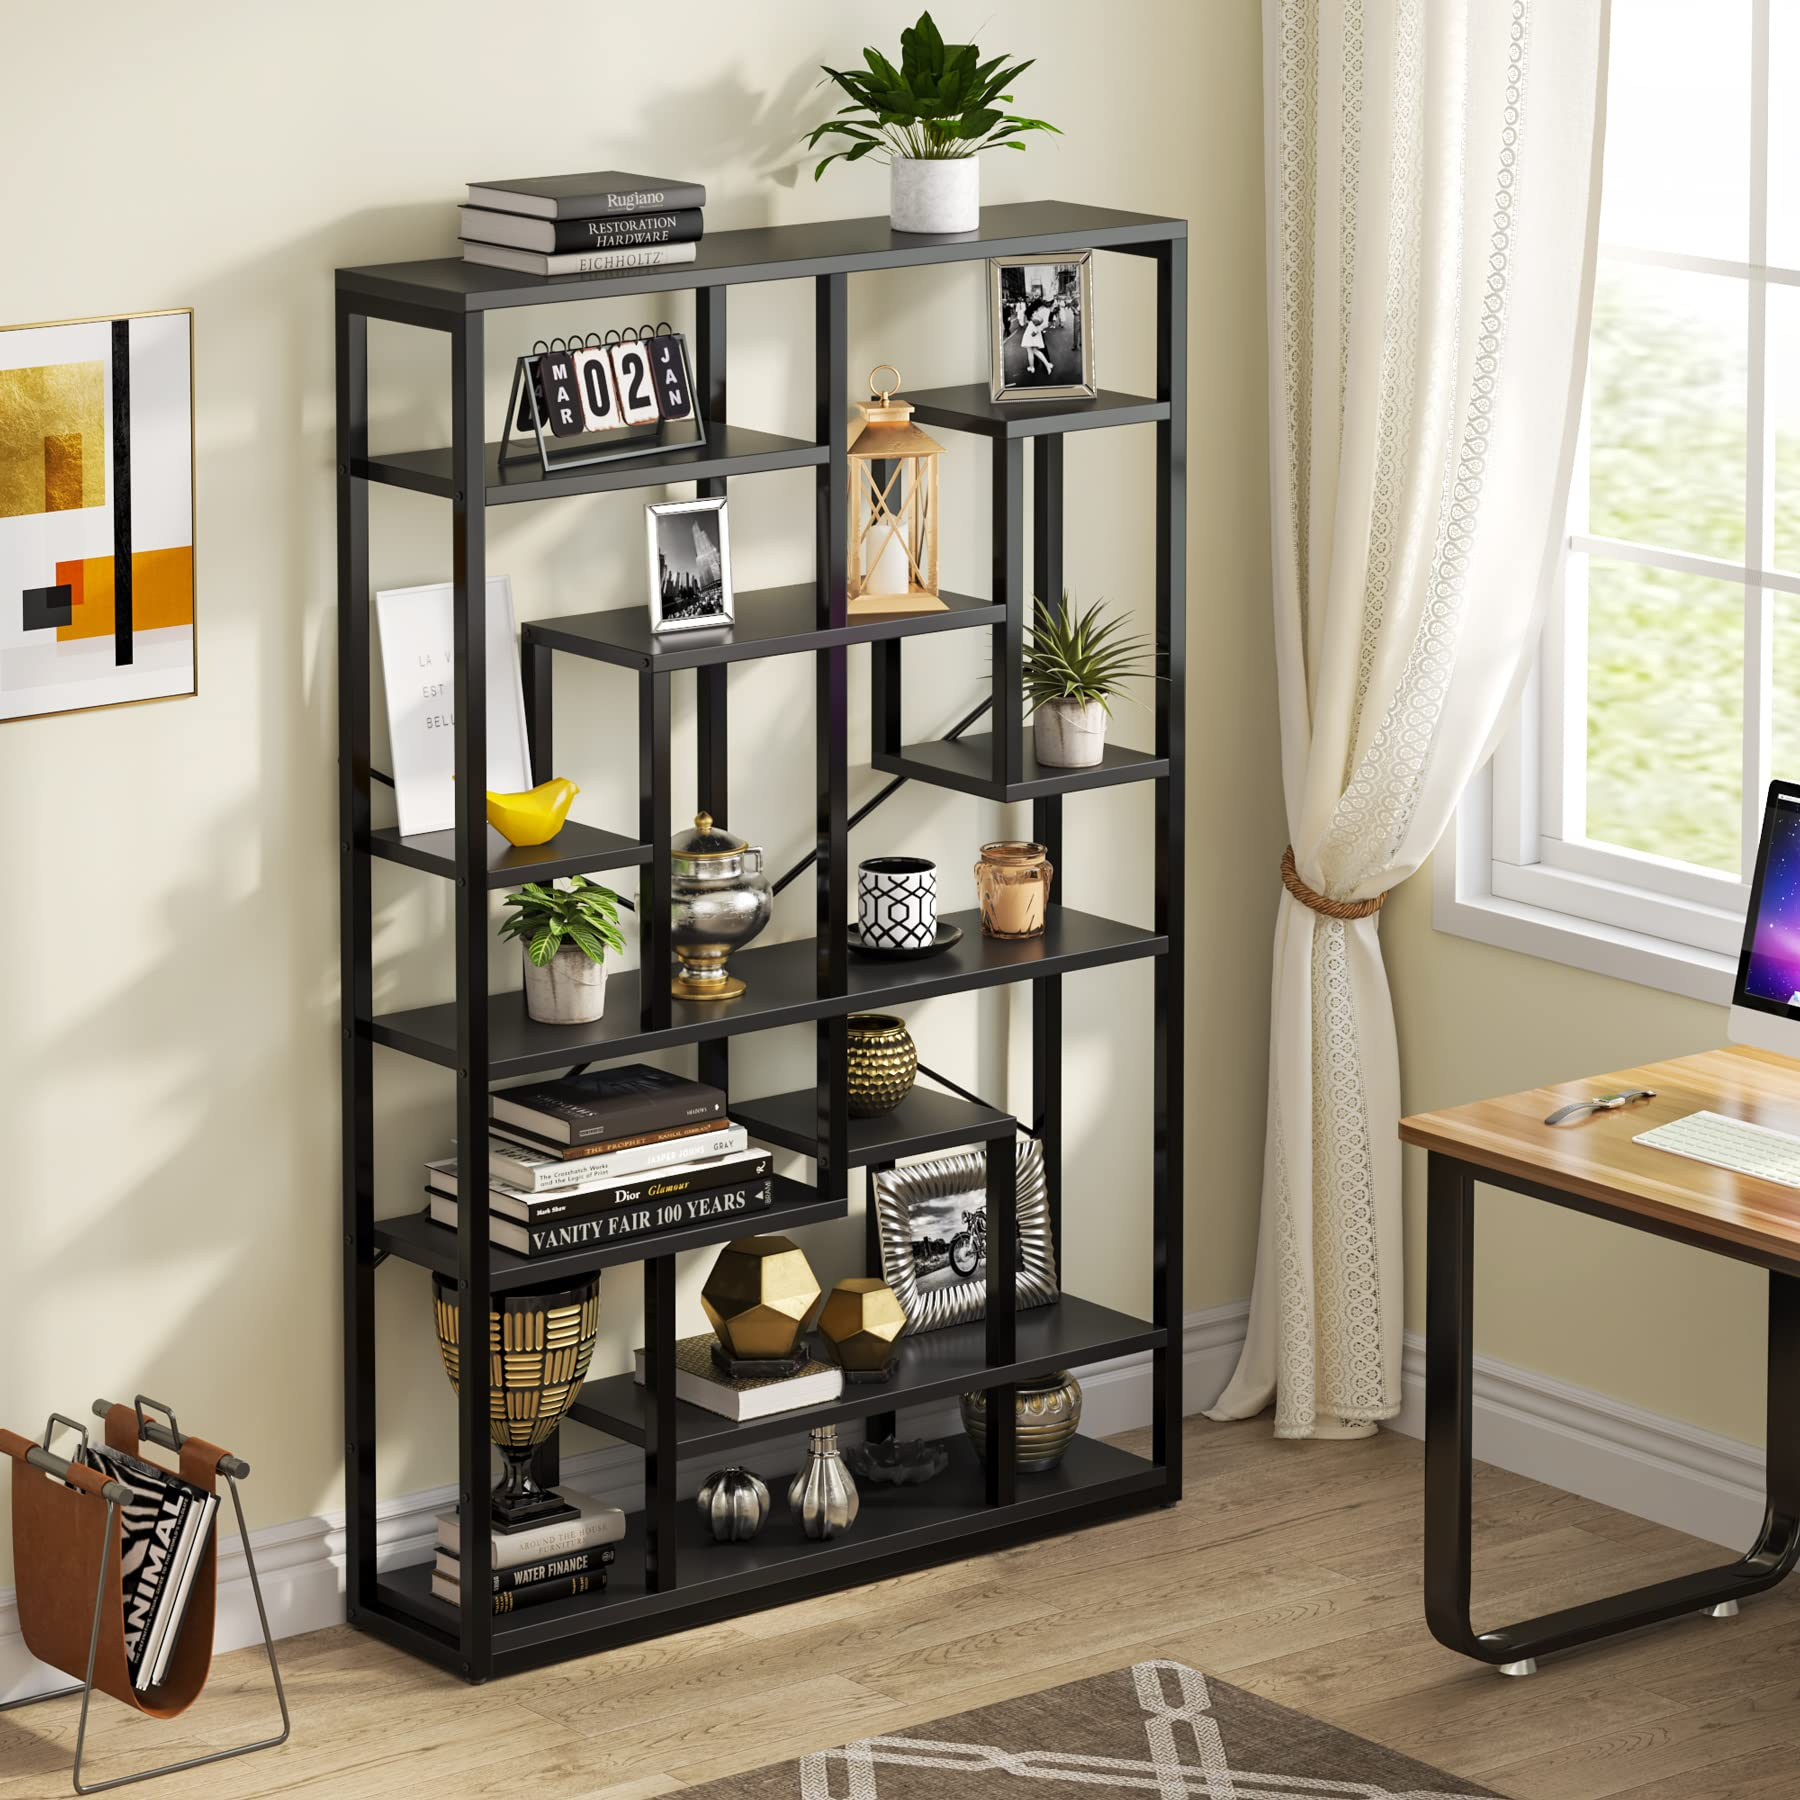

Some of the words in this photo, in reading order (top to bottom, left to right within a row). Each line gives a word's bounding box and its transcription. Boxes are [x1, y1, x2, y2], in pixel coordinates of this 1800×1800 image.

[607, 191, 664, 211] Rugiano
[588, 215, 677, 235] RESTORATION
[596, 230, 669, 247] HARDWARE
[579, 251, 662, 273] EICHHOLTZ
[551, 363, 574, 425] MAR
[660, 347, 682, 407] JAN
[418, 654, 432, 668] LA
[422, 683, 443, 698] EST
[426, 713, 454, 729] BELL
[585, 1146, 601, 1155] THE
[606, 1138, 647, 1151] PROPHET
[713, 1139, 735, 1151] GRAY
[553, 1167, 588, 1178] Crosshatch
[589, 1164, 609, 1172] Works
[567, 1174, 585, 1183] Logic
[594, 1169, 609, 1177] Print
[614, 1188, 641, 1203] Dior
[648, 1180, 690, 1197] Glamour
[536, 1207, 551, 1216] Mark
[551, 1205, 567, 1214] Shaw
[532, 1220, 603, 1251] VANITY
[608, 1211, 651, 1236] FAIR
[656, 1203, 683, 1225] 100
[687, 1190, 747, 1219] YEARS
[519, 1536, 556, 1552] AROUND
[558, 1531, 576, 1541] THE
[579, 1522, 608, 1537] HOUSE
[537, 1537, 586, 1553] FURNITURE
[126, 1495, 185, 1663] ANIMAL
[513, 1565, 546, 1586] WATER
[547, 1555, 588, 1578] FINANCE
